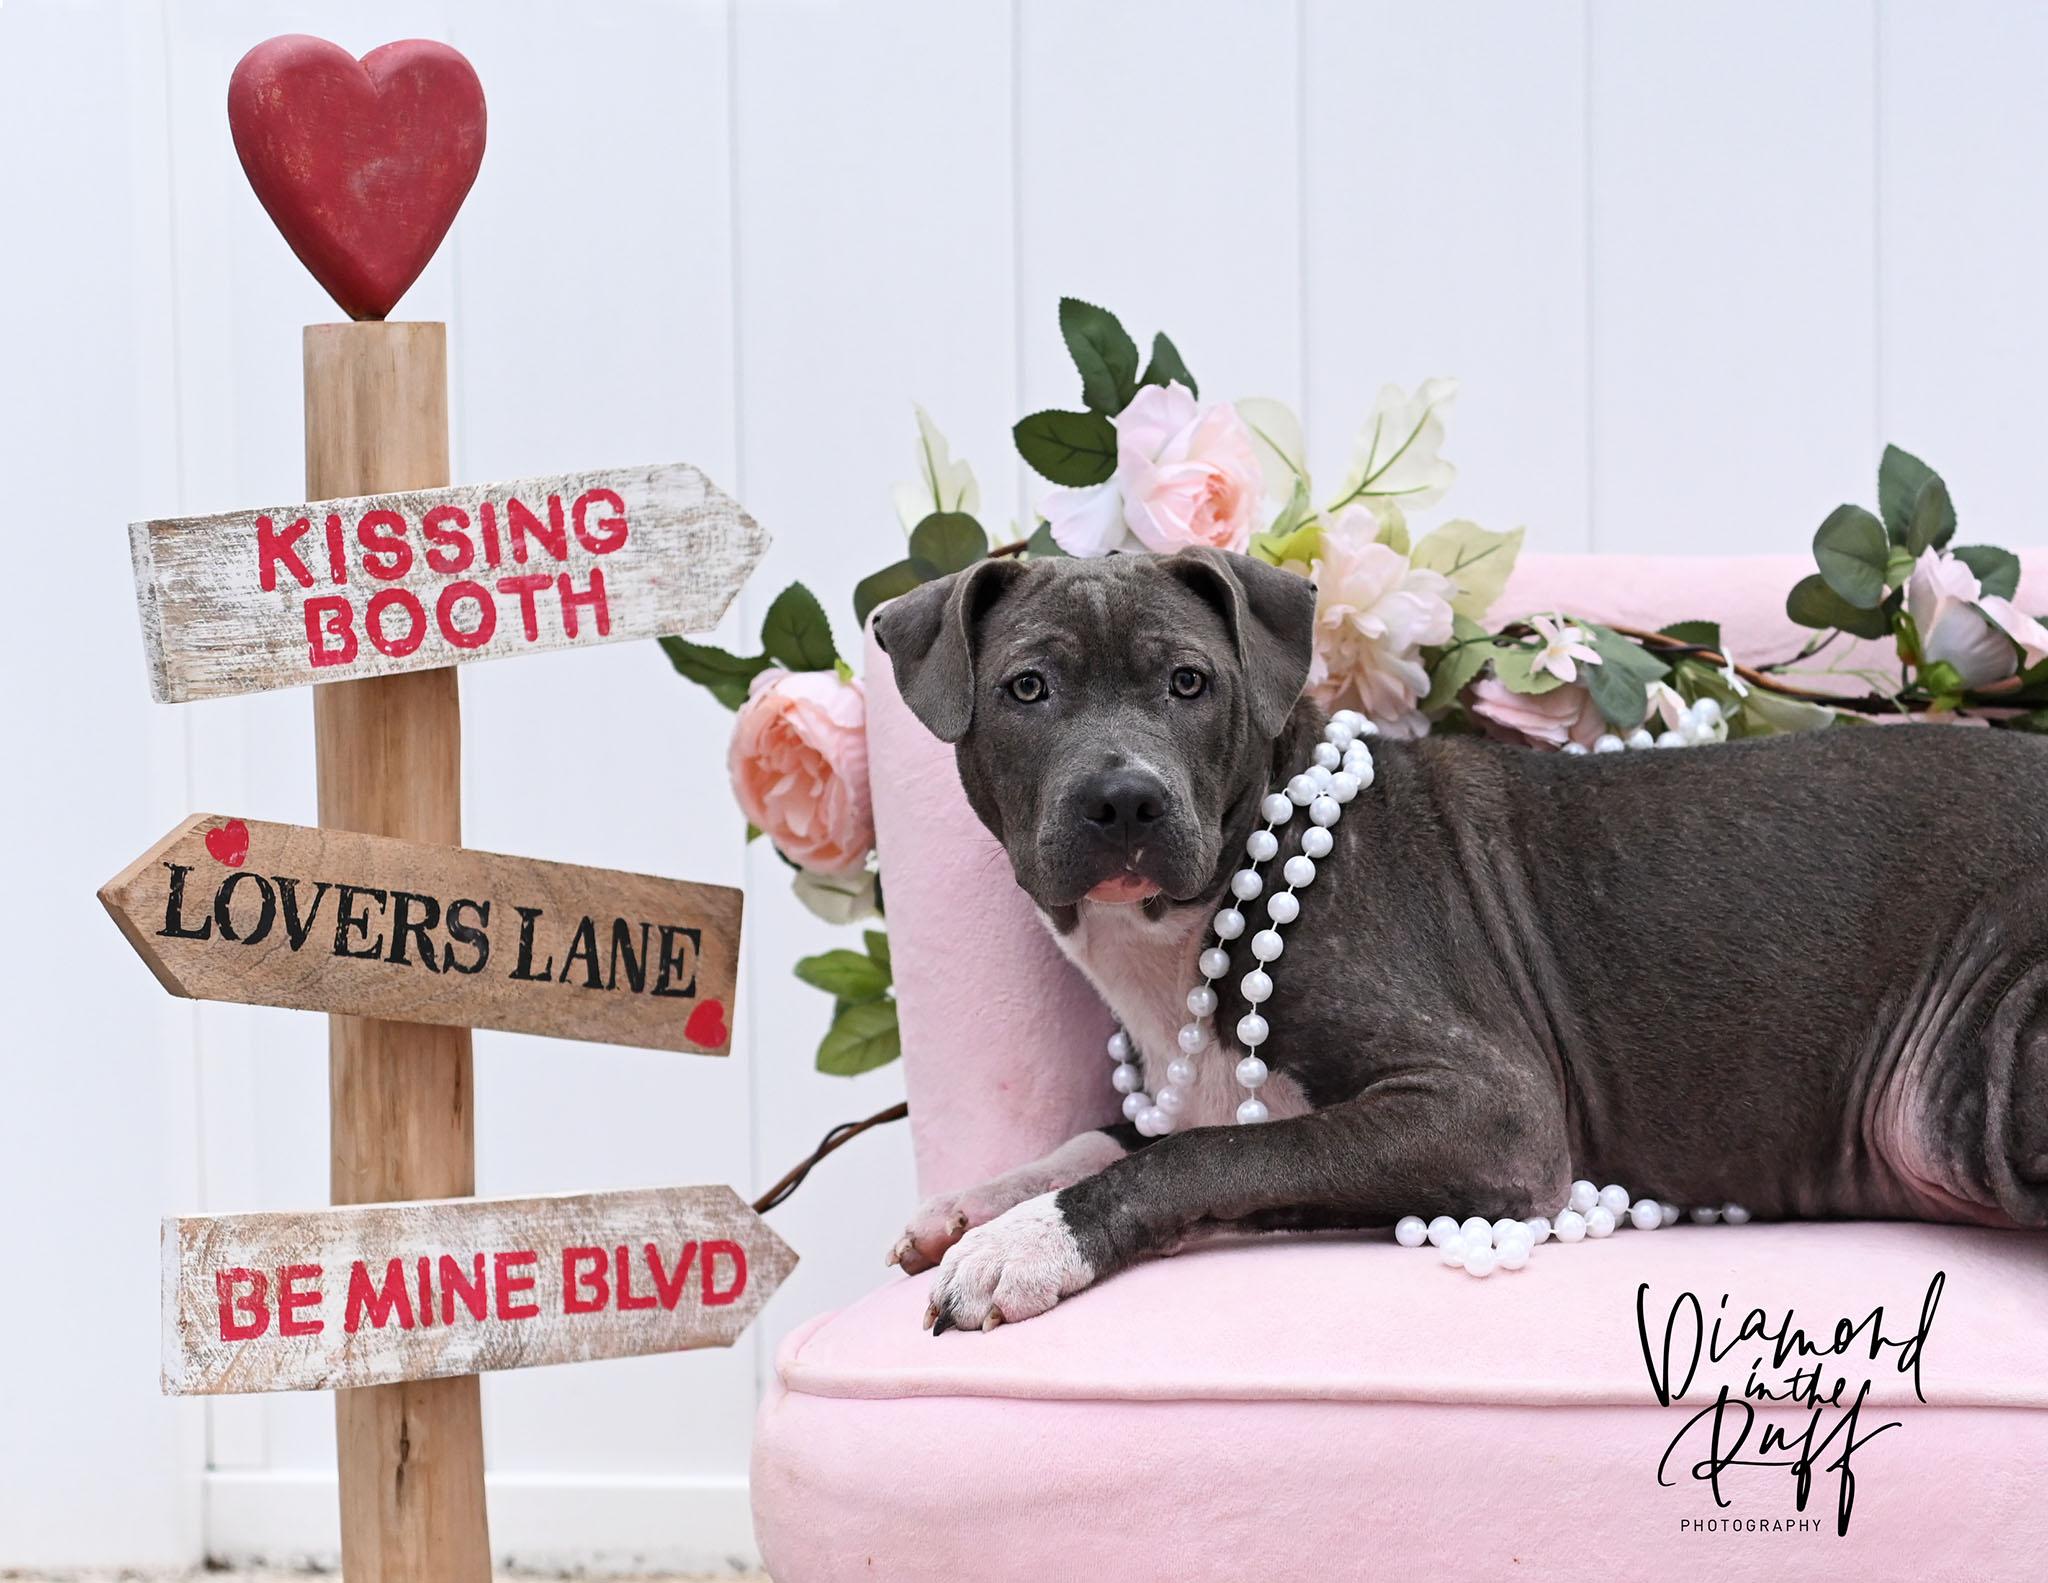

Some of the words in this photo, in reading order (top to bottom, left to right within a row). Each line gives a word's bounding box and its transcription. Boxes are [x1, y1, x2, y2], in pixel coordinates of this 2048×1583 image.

[256, 487, 629, 591] KISSING
[304, 567, 611, 668] BOOTH
[155, 861, 493, 976] LOVERS
[508, 906, 703, 999] LANE
[216, 1263, 324, 1342] BE
[344, 1249, 538, 1334] MINE
[562, 1238, 748, 1315] BLVD
